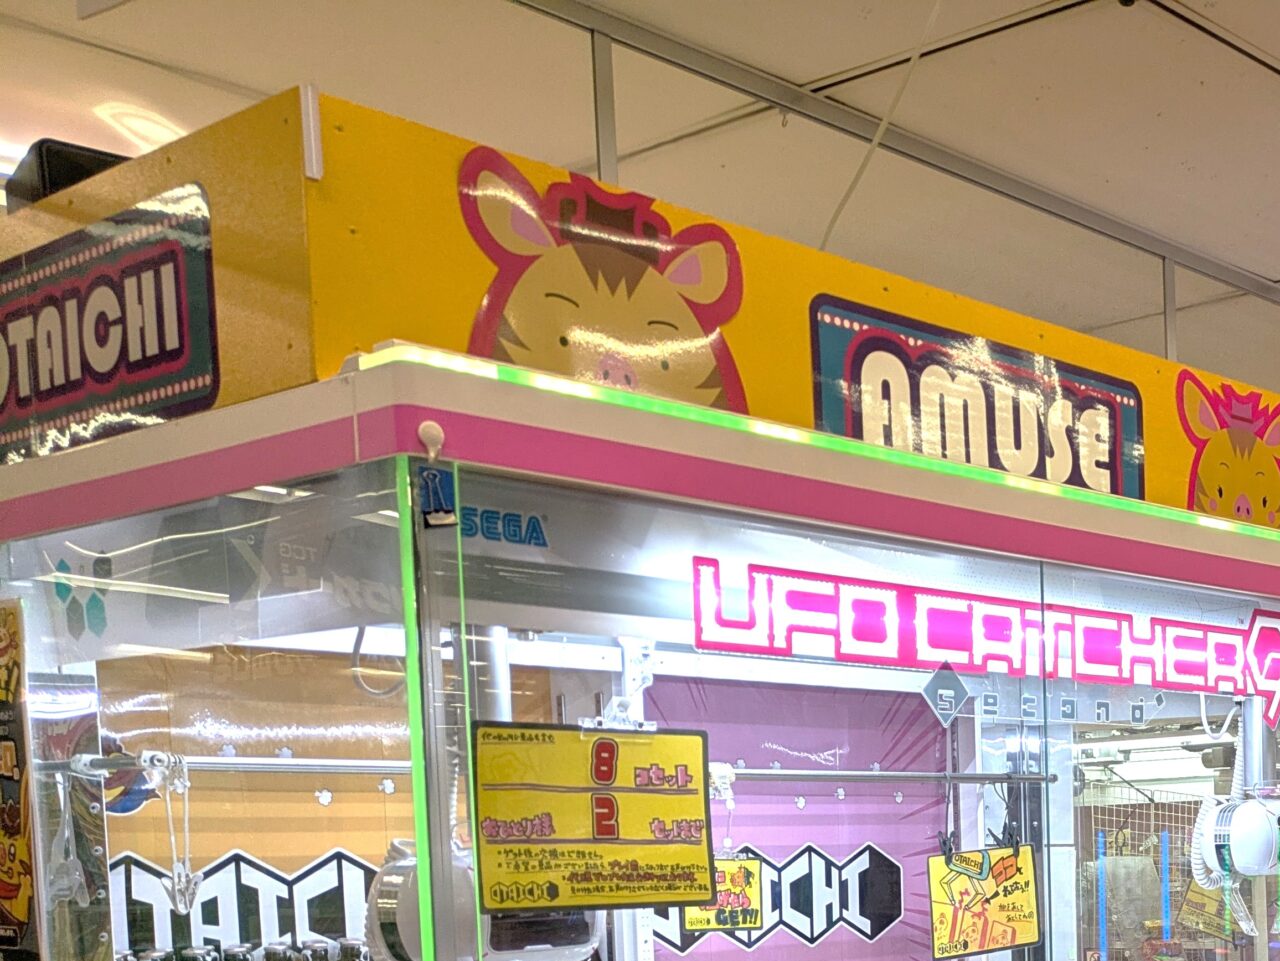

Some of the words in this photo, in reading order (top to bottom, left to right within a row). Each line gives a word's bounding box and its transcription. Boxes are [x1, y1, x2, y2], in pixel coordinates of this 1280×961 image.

[0, 262, 179, 402] TAICHI
[859, 348, 1112, 494] AMUSE
[462, 507, 549, 549] SEGA
[591, 737, 619, 786] 8
[481, 812, 556, 838] おひとり様
[591, 793, 619, 840] 2
